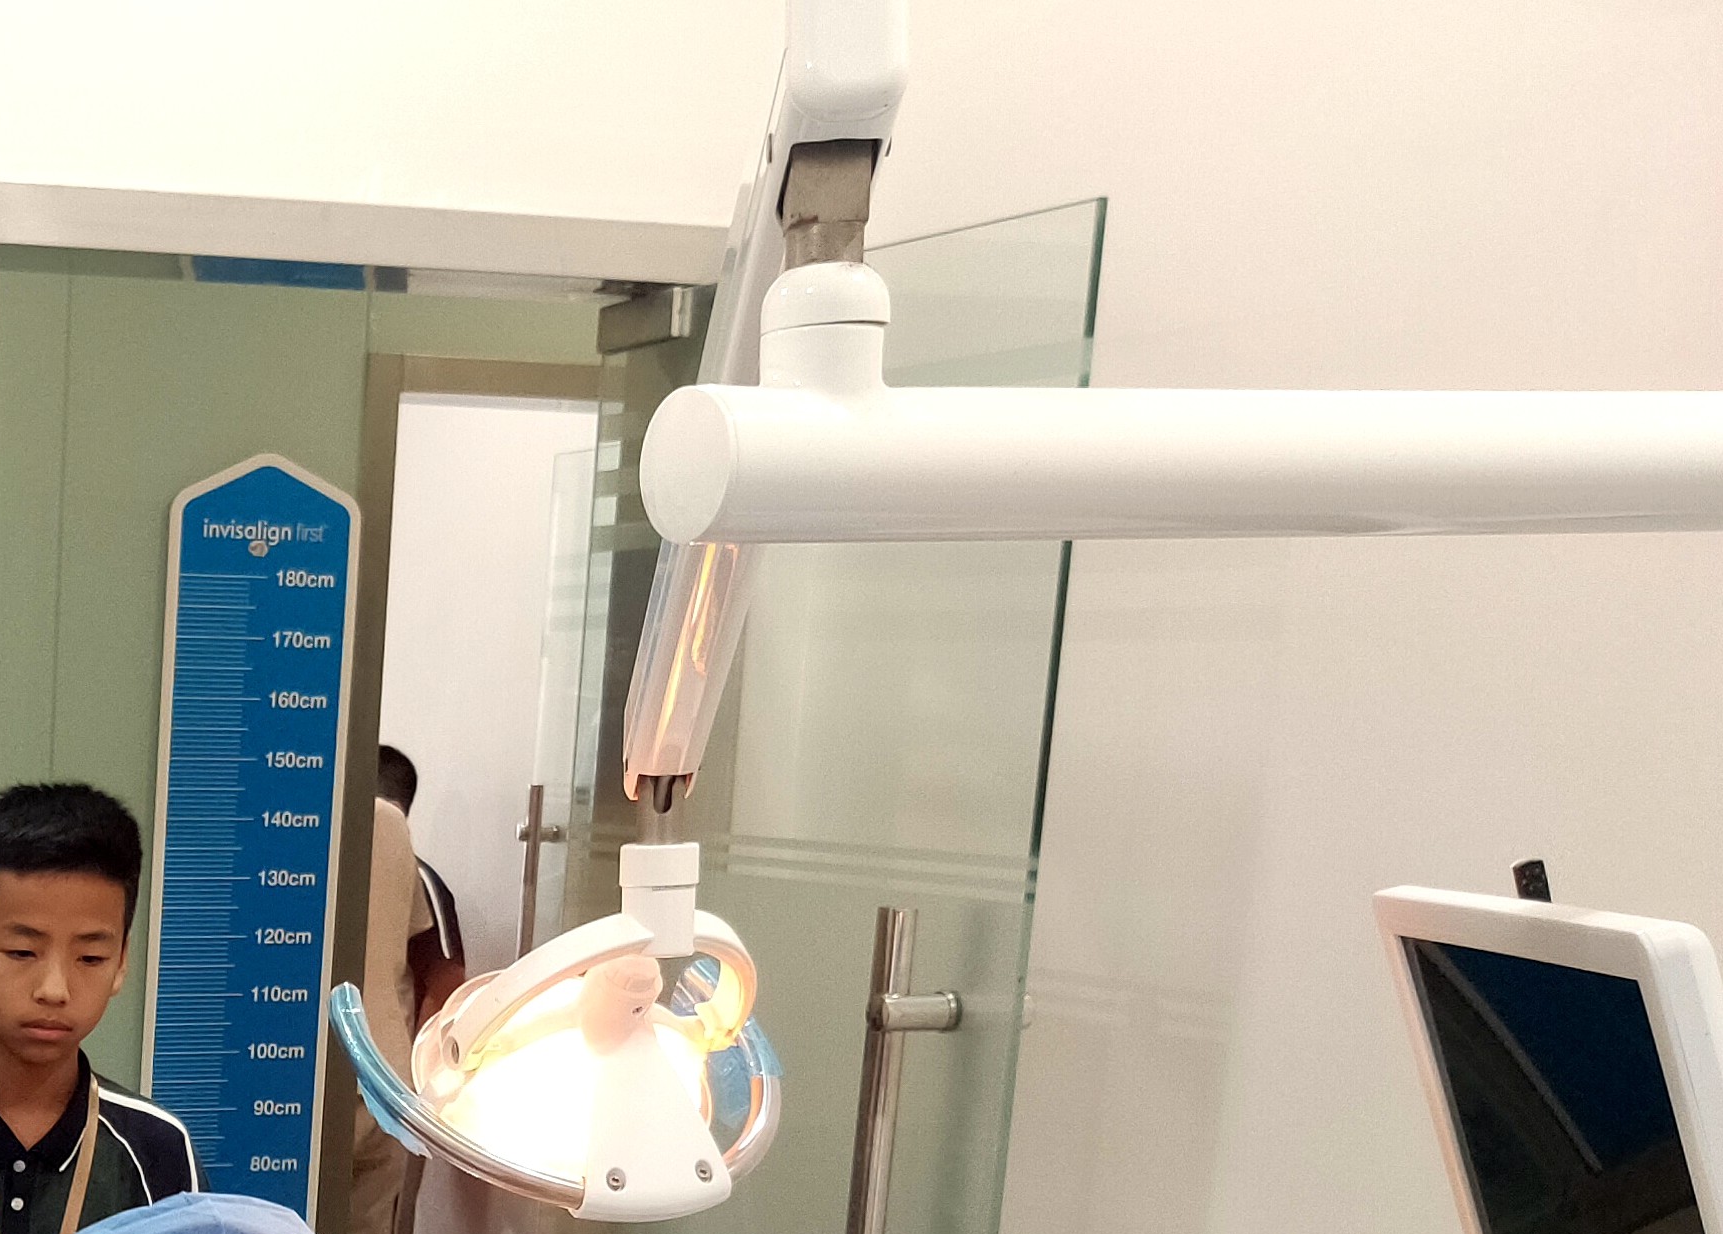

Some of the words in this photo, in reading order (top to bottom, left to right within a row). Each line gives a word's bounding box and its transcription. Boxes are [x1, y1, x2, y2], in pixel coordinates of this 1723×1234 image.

[203, 518, 292, 545] invisalign
[296, 523, 324, 543] first
[275, 570, 335, 589] 180cm
[272, 631, 331, 650] 170cm
[268, 692, 328, 710] 160cm
[265, 752, 324, 770] 150cm
[261, 811, 320, 828] 140cm
[257, 870, 316, 887] 130cm
[254, 928, 312, 945] 120cm
[250, 986, 309, 1003] 110cm
[247, 1043, 305, 1060] 100cm
[253, 1100, 301, 1117] 90cm
[249, 1156, 298, 1173] 80cm
